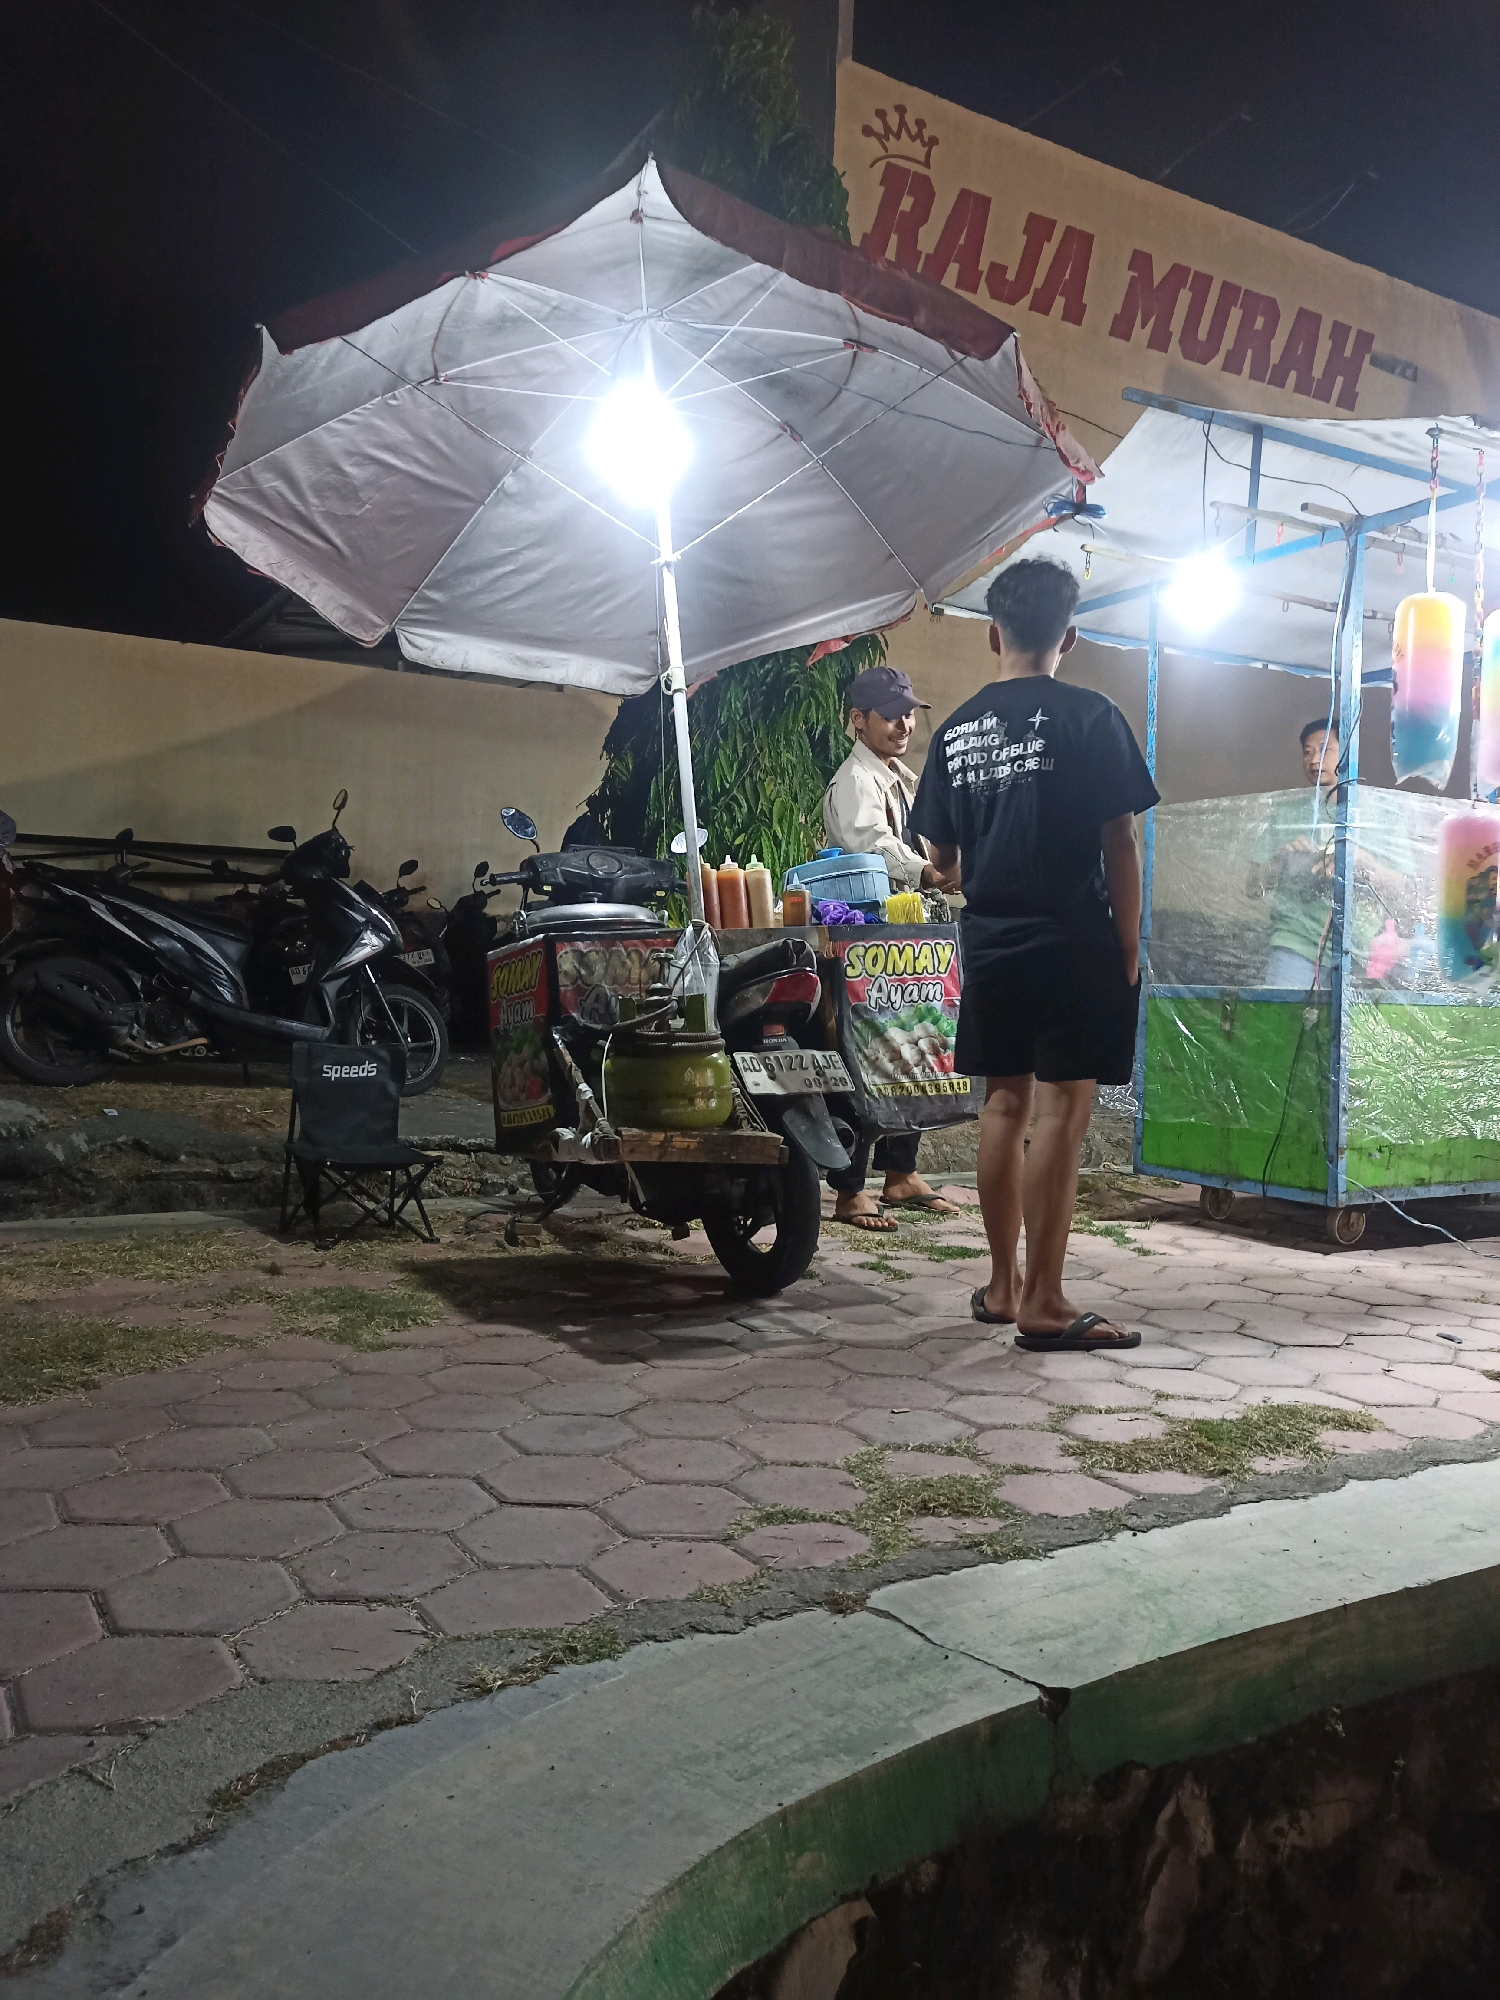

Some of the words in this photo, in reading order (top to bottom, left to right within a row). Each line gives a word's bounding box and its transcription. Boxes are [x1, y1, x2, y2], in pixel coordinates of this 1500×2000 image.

[860, 161, 1095, 326] RAJA
[1109, 249, 1375, 411] MURAH
[490, 949, 543, 1002] SOMAY
[845, 942, 955, 979] SOMAY
[867, 975, 944, 1011] Ayam
[498, 998, 535, 1034] Ayam
[322, 1060, 378, 1081] speeds
[740, 1056, 763, 1073] AD
[811, 1053, 843, 1071] AJE
